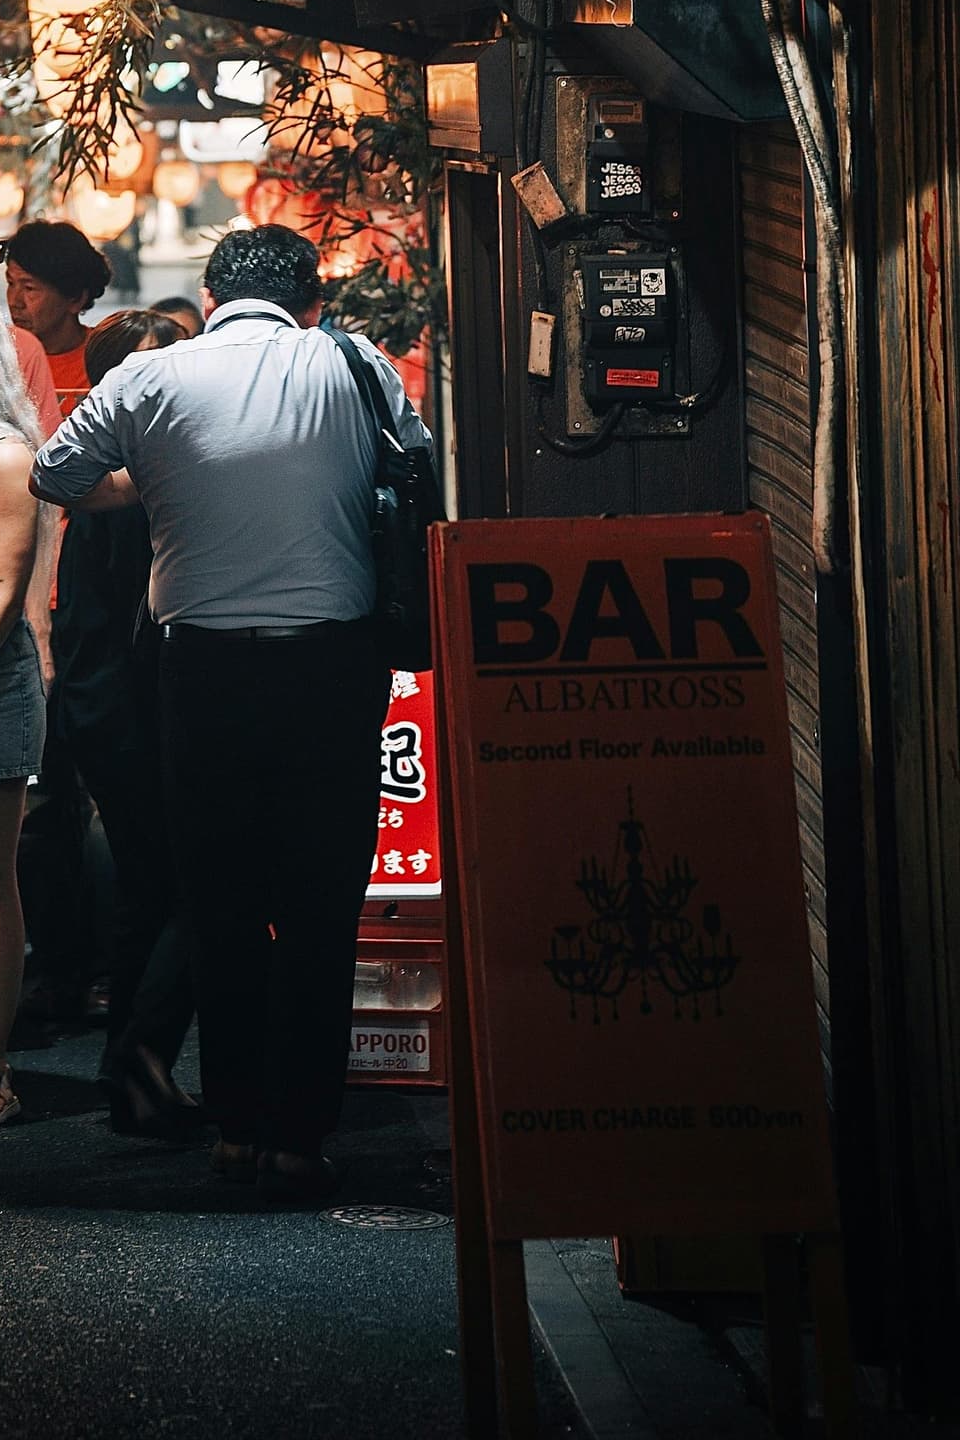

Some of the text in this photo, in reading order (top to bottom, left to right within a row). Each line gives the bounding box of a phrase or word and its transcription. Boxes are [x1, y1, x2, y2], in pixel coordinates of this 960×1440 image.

[600, 182, 642, 199] JESS3
[467, 556, 765, 664] BAR
[504, 676, 747, 713] ALBATROSS
[478, 734, 766, 762] Second Floor Available
[501, 1110, 586, 1134] COVER
[593, 1106, 696, 1132] CHARGE
